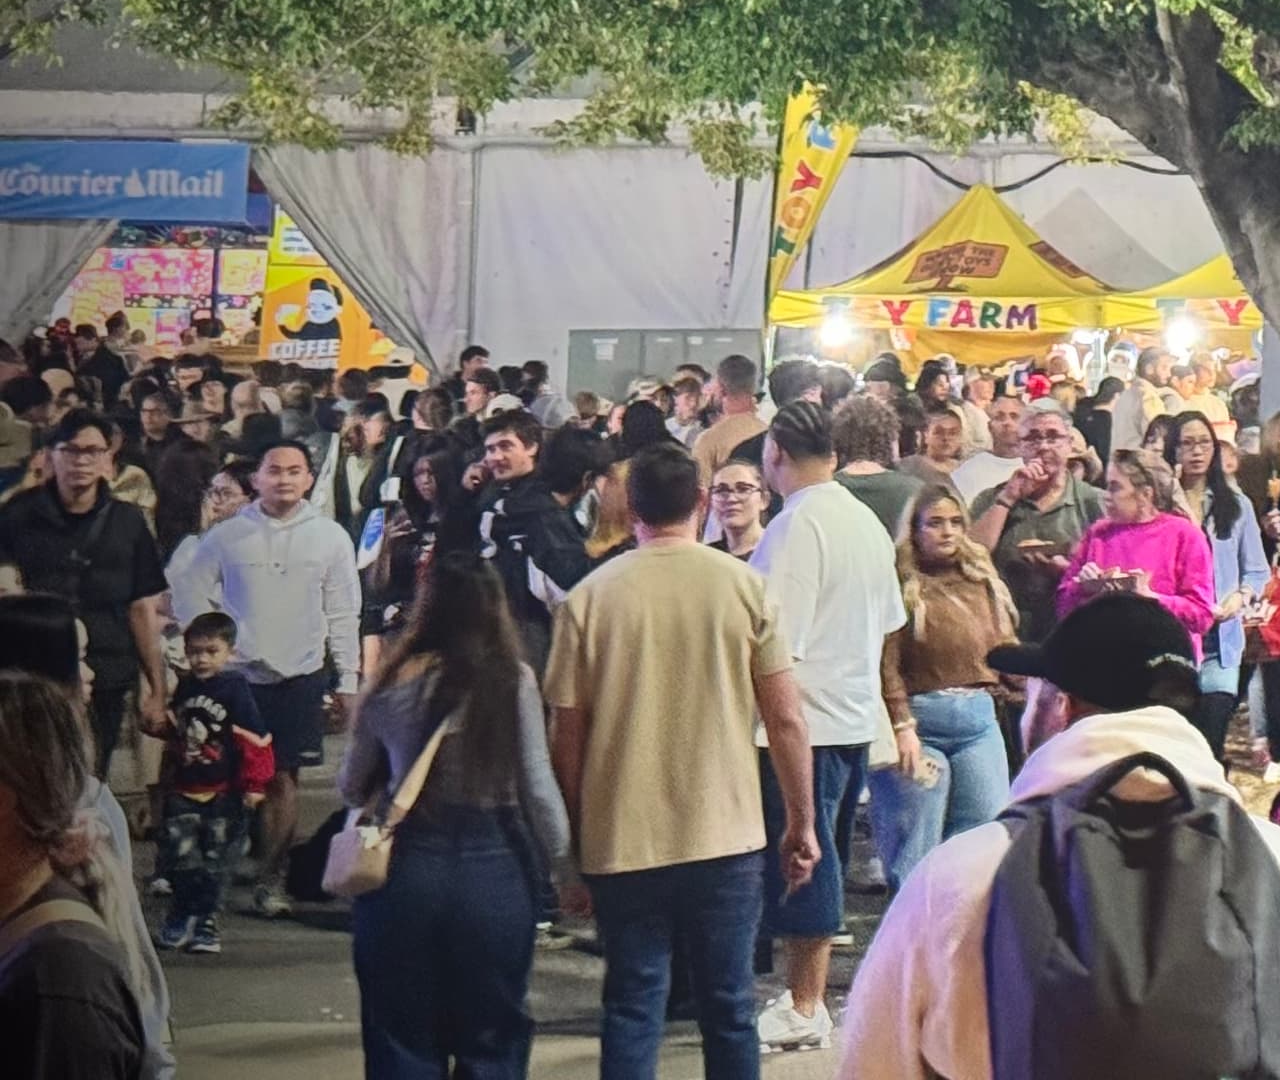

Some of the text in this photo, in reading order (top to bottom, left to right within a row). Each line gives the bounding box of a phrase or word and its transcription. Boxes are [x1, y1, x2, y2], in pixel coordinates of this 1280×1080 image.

[146, 168, 224, 198] Mail
[769, 159, 823, 258] TOY
[822, 295, 1038, 331] TY FARM
[1156, 297, 1249, 326] TY
